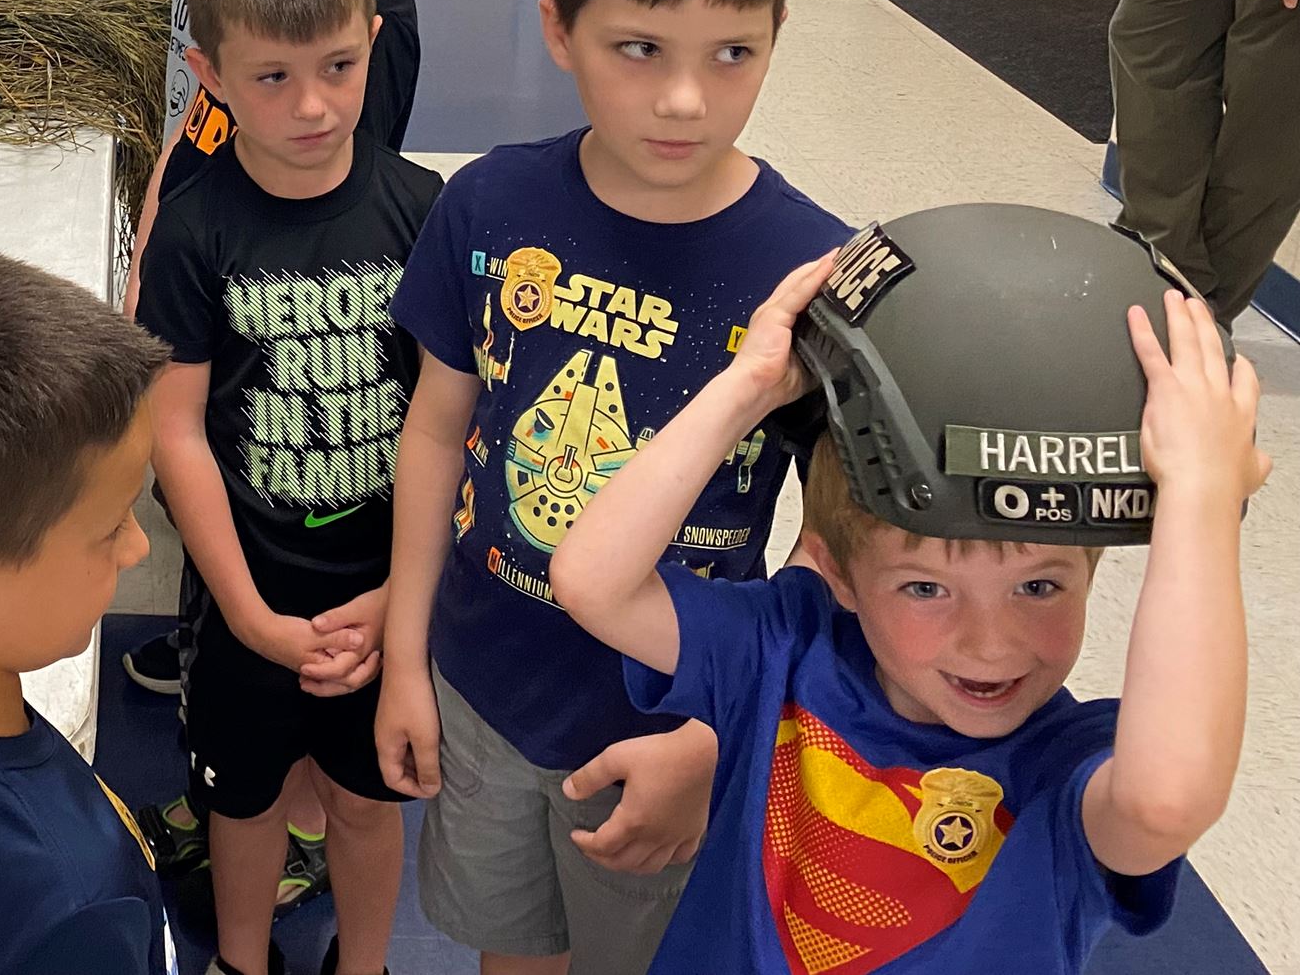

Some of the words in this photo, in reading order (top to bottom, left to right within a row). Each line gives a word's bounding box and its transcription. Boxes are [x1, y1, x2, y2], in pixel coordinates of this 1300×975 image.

[550, 297, 676, 360] WARS
[555, 273, 679, 334] STAR
[266, 328, 384, 395] RUN
[247, 388, 312, 448] IN
[312, 377, 404, 447] THE
[1035, 508, 1073, 522] POS
[1091, 487, 1156, 520] NKD
[922, 844, 947, 864] POLICE
